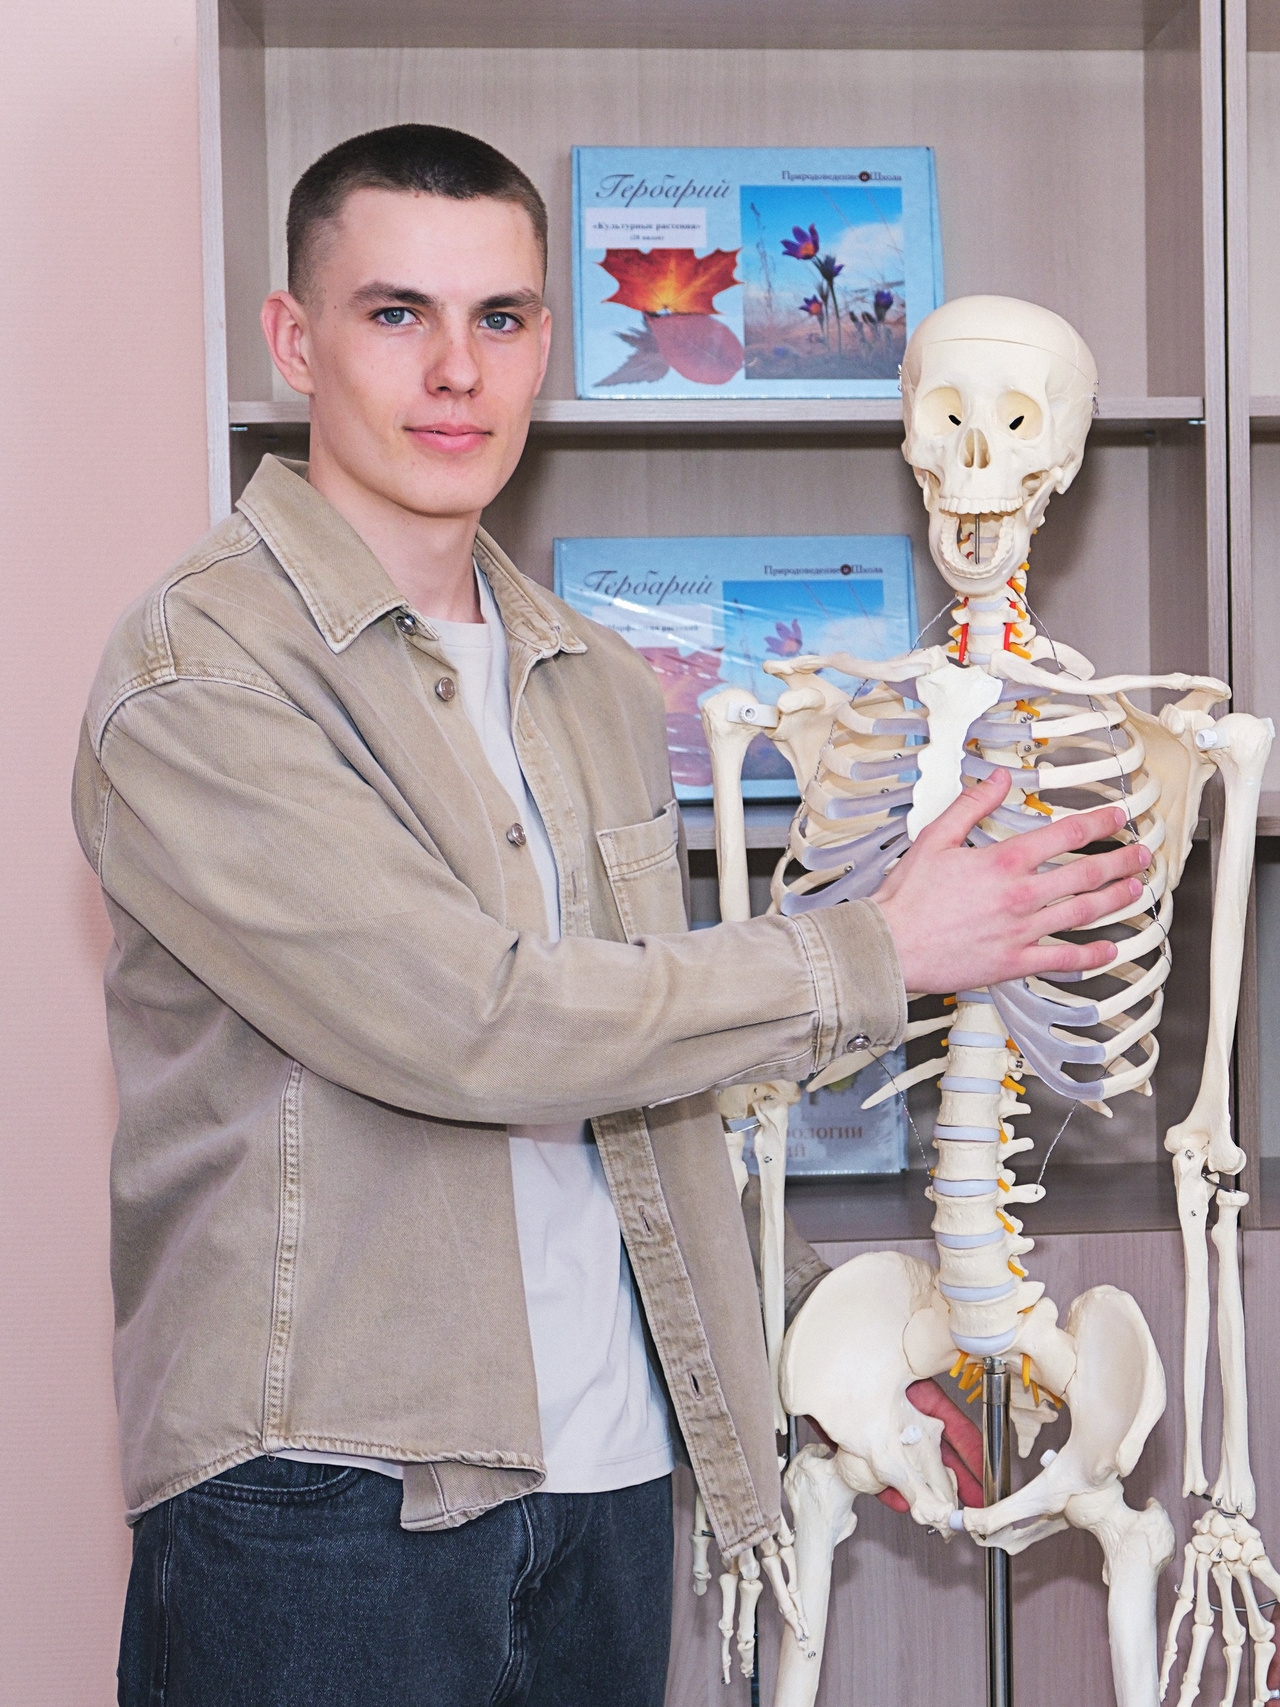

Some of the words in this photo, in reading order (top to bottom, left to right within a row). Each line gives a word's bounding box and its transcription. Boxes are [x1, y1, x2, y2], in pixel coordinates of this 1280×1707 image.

[781, 170, 859, 182] Природоведение
[870, 171, 902, 181] Школа
[595, 174, 730, 208] Гербарий
[764, 565, 841, 576] Природоведение
[851, 564, 883, 574] Школа
[580, 570, 713, 606] Гербарий
